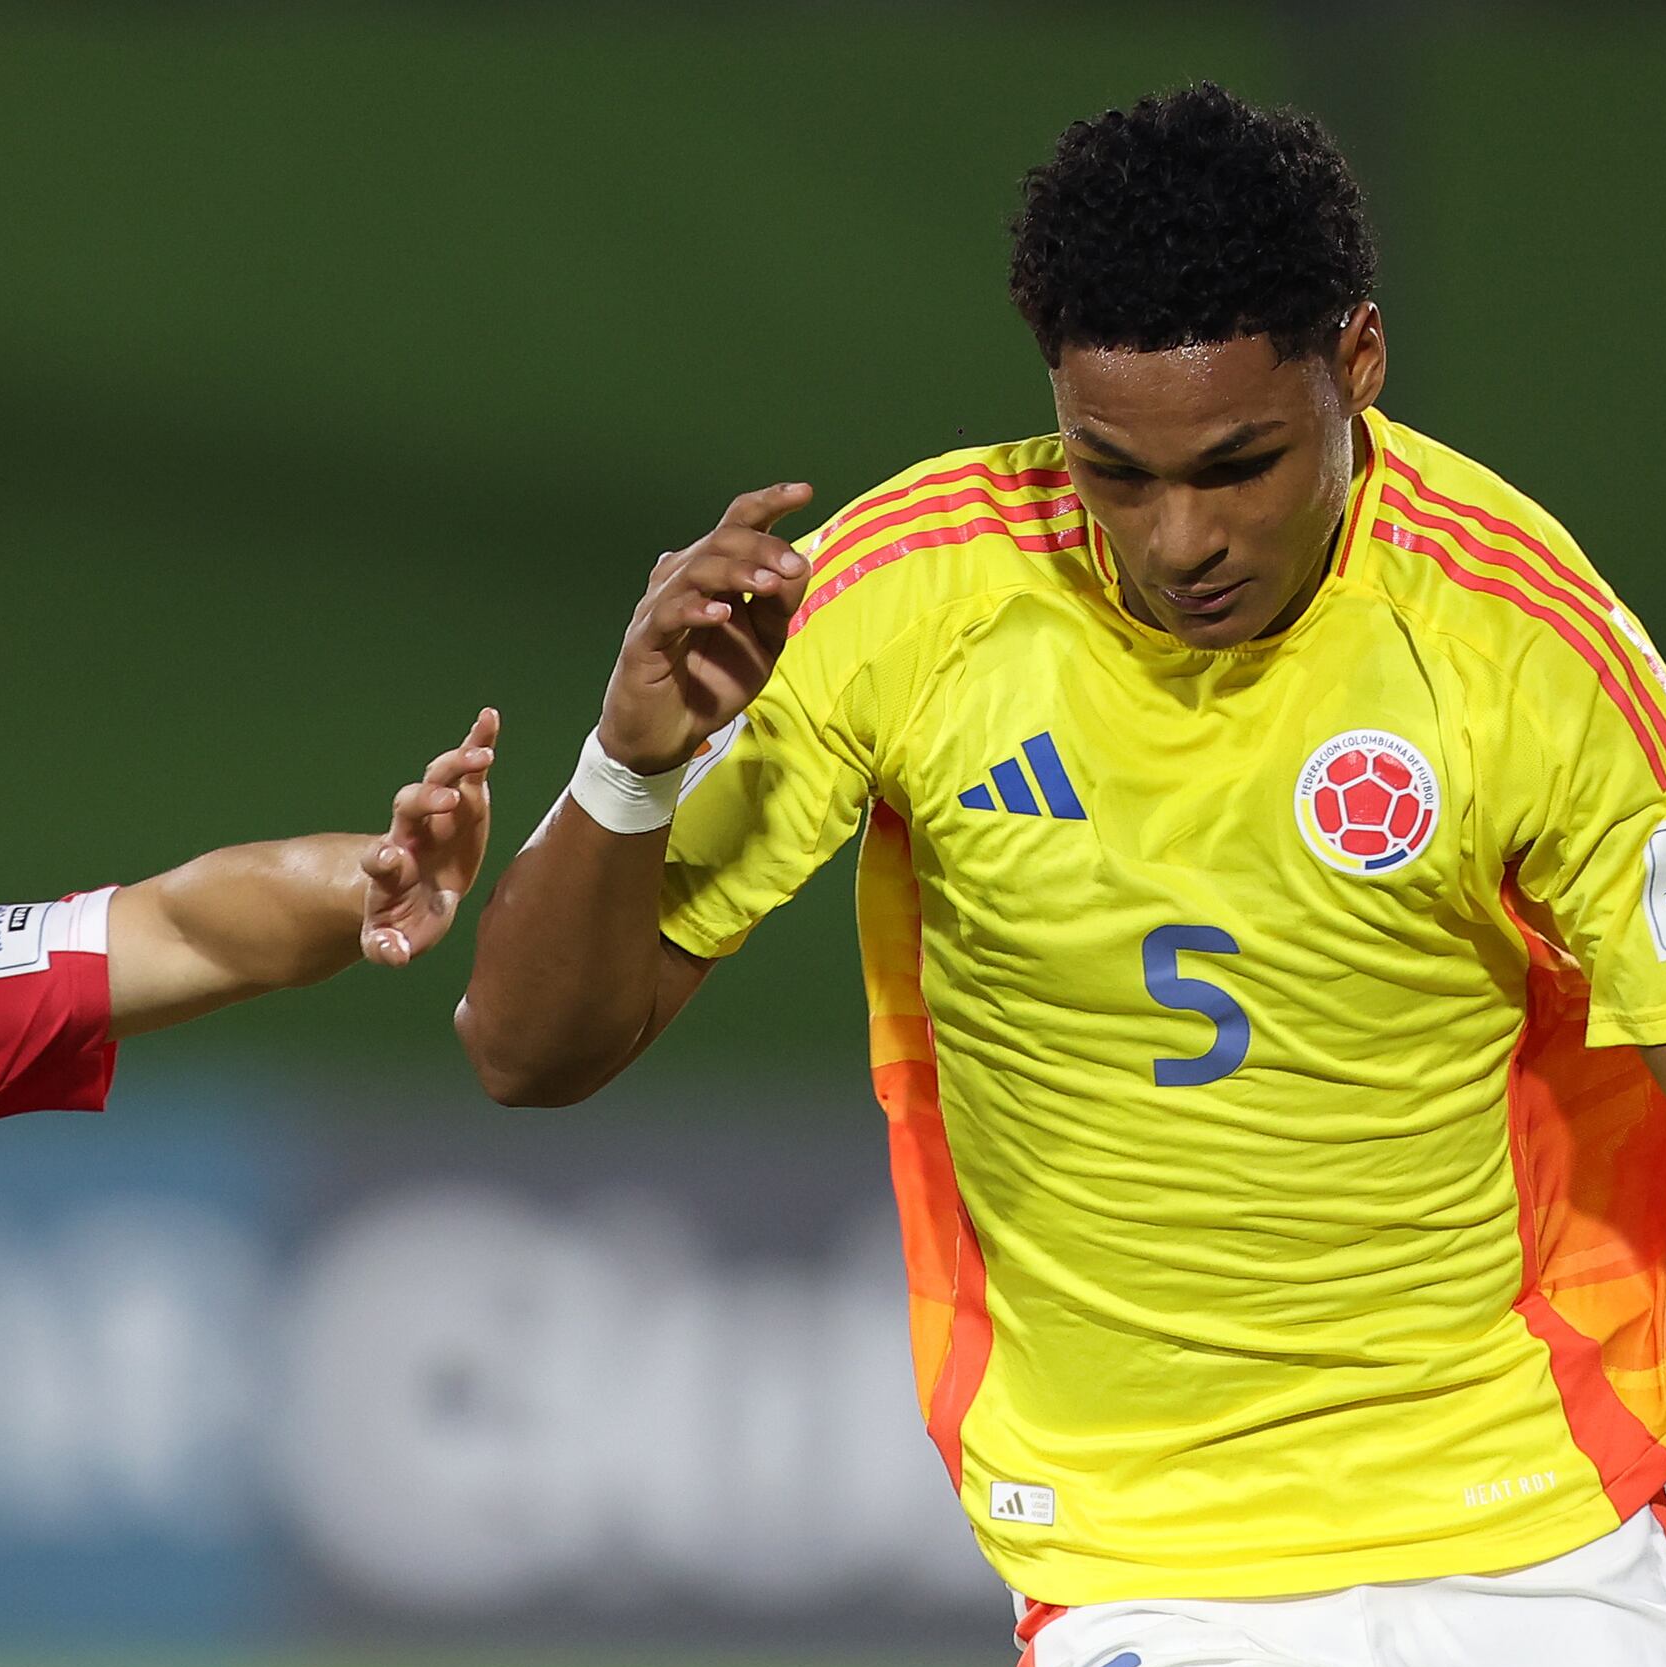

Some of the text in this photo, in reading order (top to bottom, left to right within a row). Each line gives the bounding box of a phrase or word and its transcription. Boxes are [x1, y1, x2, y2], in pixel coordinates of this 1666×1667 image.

[1342, 735, 1408, 758] COLOMBIANA
[1407, 754, 1420, 768] DE
[1142, 924, 1250, 1087] 5
